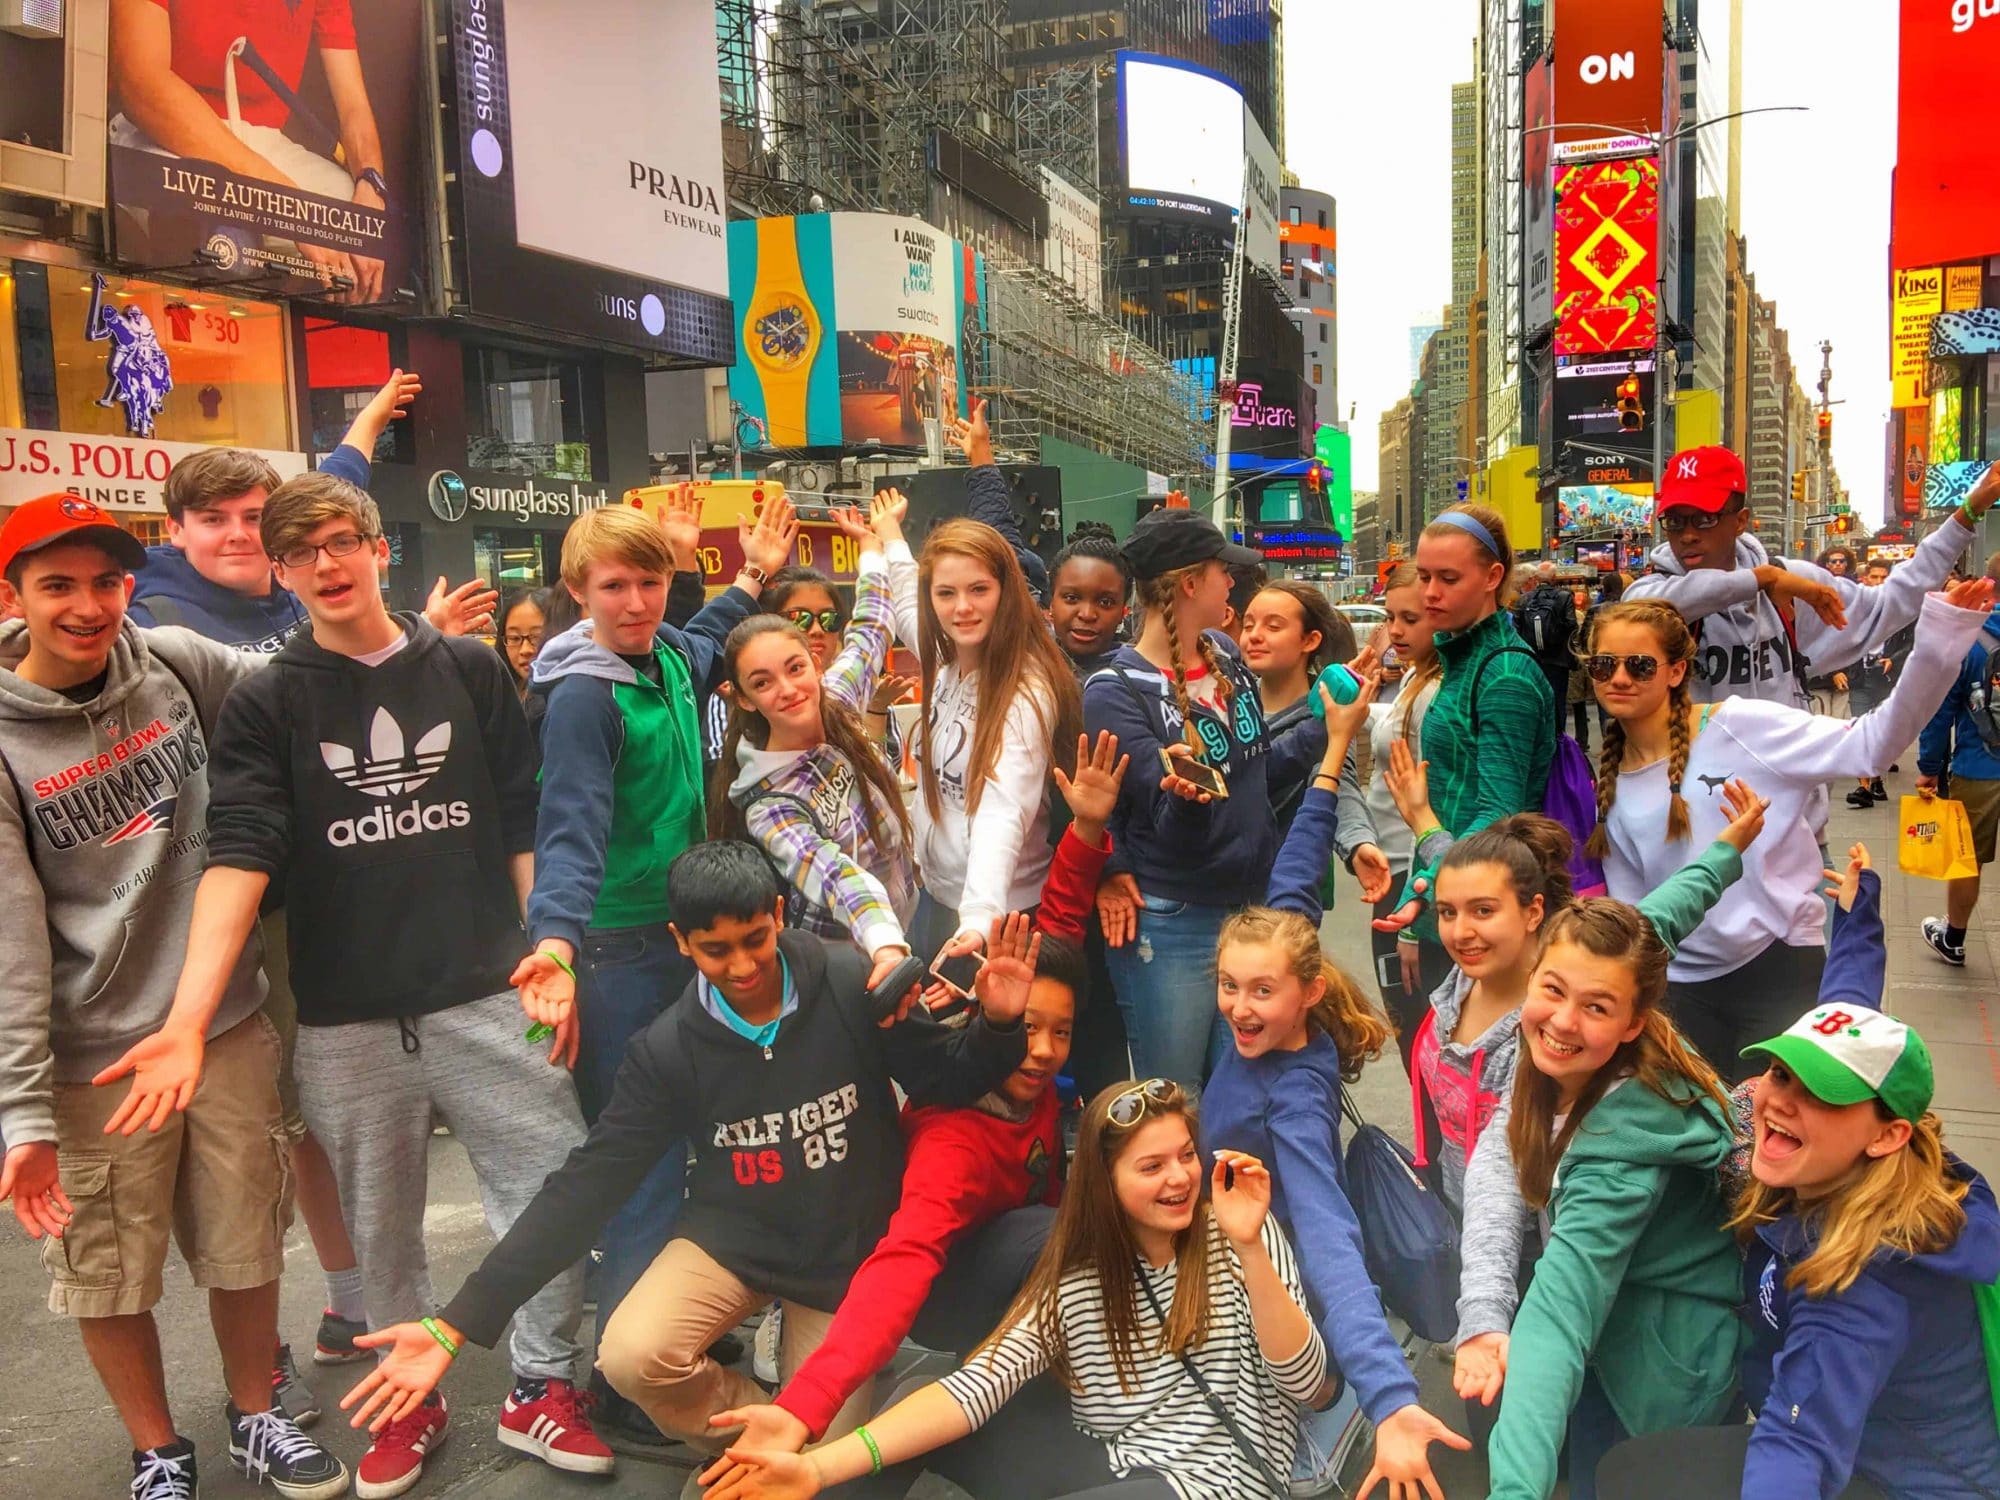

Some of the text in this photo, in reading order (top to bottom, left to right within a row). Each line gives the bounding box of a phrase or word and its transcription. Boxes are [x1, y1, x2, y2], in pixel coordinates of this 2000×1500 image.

[1579, 51, 1635, 85] ON
[1611, 137, 1650, 148] DONUTS
[628, 160, 721, 215] PRADA
[162, 166, 386, 240] LIVE AUTHENTICALLY
[1157, 199, 1164, 207] TO
[193, 201, 222, 217] JONNY
[223, 208, 255, 223] LAVINE
[263, 216, 273, 227] 17
[274, 219, 296, 233] YEAR
[296, 223, 314, 236] OLD
[313, 227, 335, 242] POLO
[335, 232, 363, 248] PLAYER
[664, 209, 722, 238] EYEWEAR
[894, 228, 935, 252] I ALWAYS
[241, 247, 286, 264] OFFICIALLY
[286, 255, 314, 270] SEALED
[905, 246, 932, 264] WANT
[1898, 276, 1938, 298] KING
[205, 316, 240, 344] $30
[69, 442, 172, 482] POLO
[1584, 456, 1626, 466] SONY
[1587, 468, 1633, 482] GENERAL
[66, 486, 147, 505] SINCE
[470, 480, 608, 523] sunglass hut
[1705, 631, 1792, 686] OBEY
[33, 718, 174, 800] SUPER BOWL
[33, 716, 209, 851] CHAMPIONS
[327, 799, 471, 848] adidas
[1811, 1010, 1855, 1036] B
[732, 1122, 849, 1187] US 85
